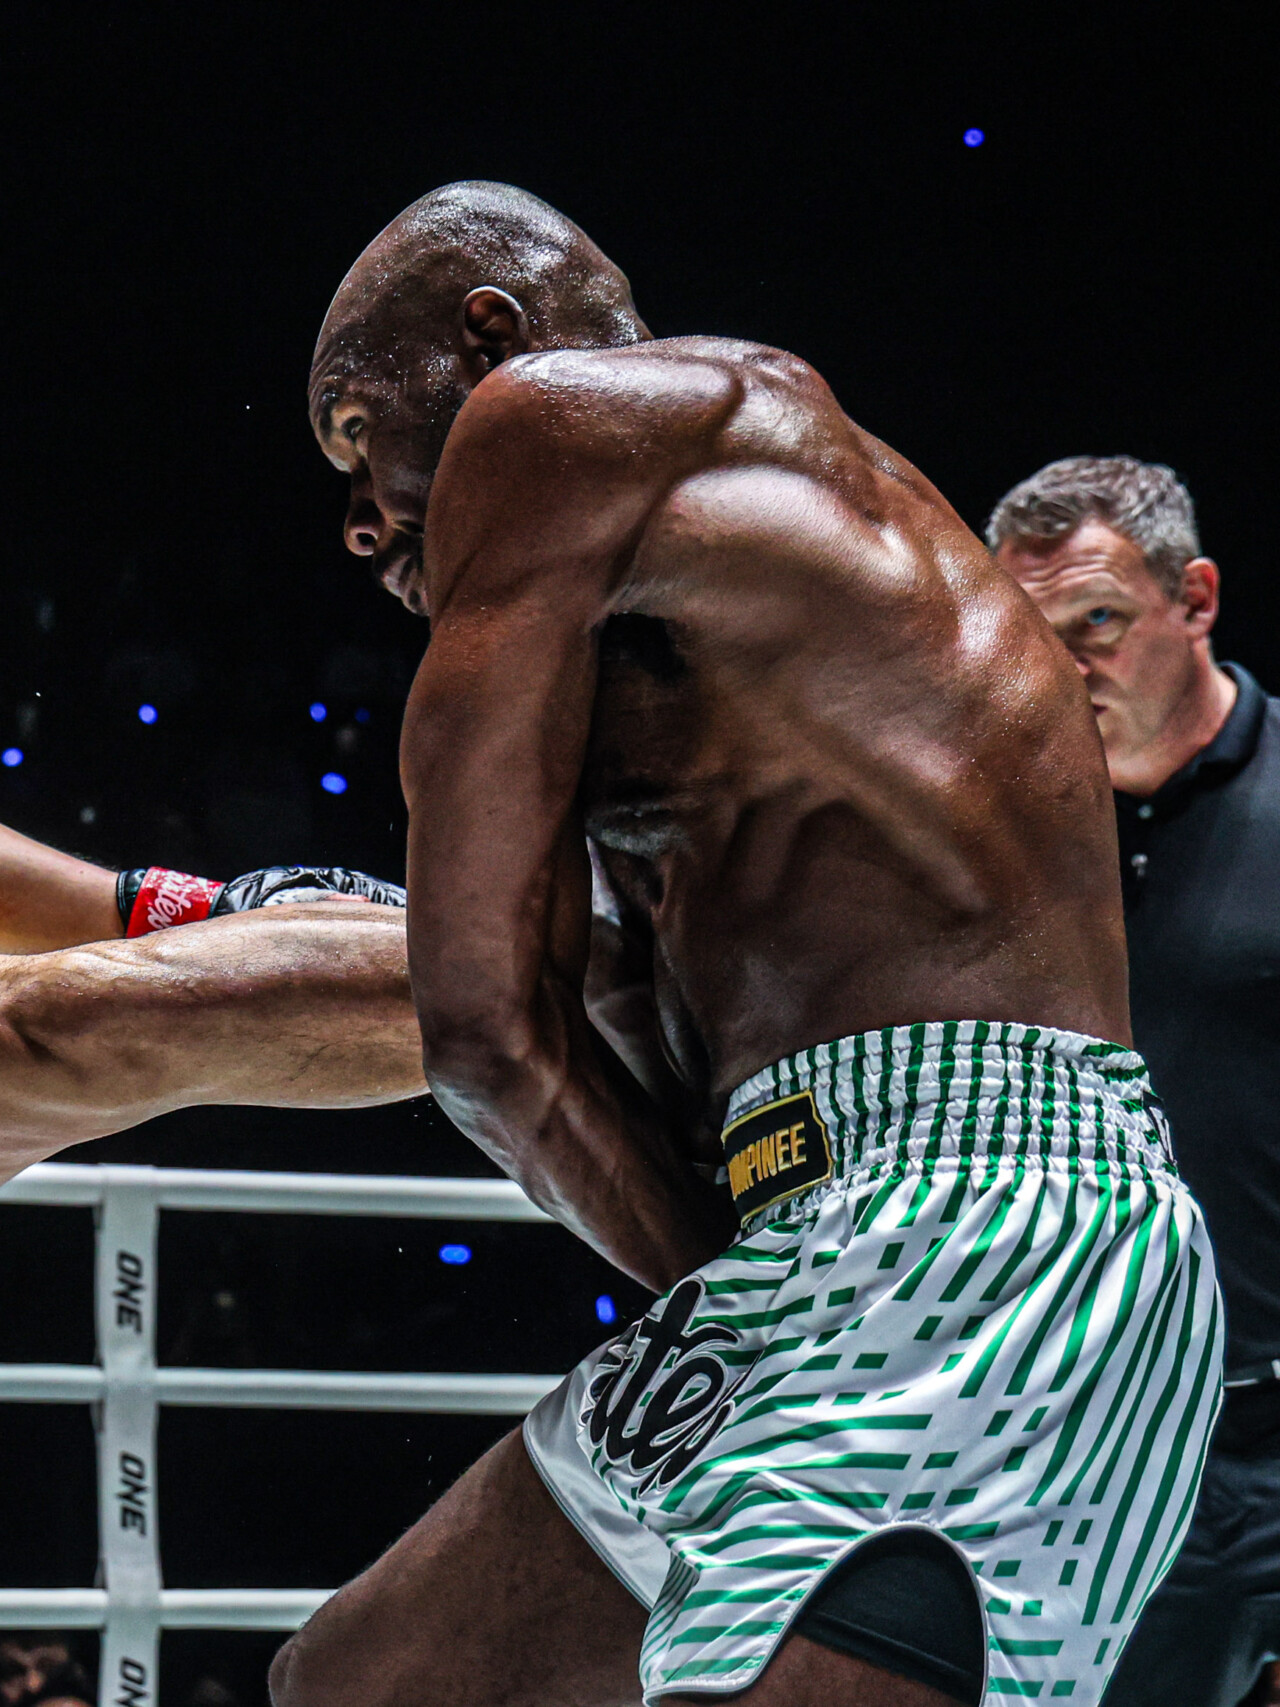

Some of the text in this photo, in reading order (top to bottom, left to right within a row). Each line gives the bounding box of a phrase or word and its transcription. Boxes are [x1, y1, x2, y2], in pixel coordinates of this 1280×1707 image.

[111, 1249, 146, 1335] ONE
[115, 1451, 150, 1537] ONE
[117, 1656, 148, 1707] ON
